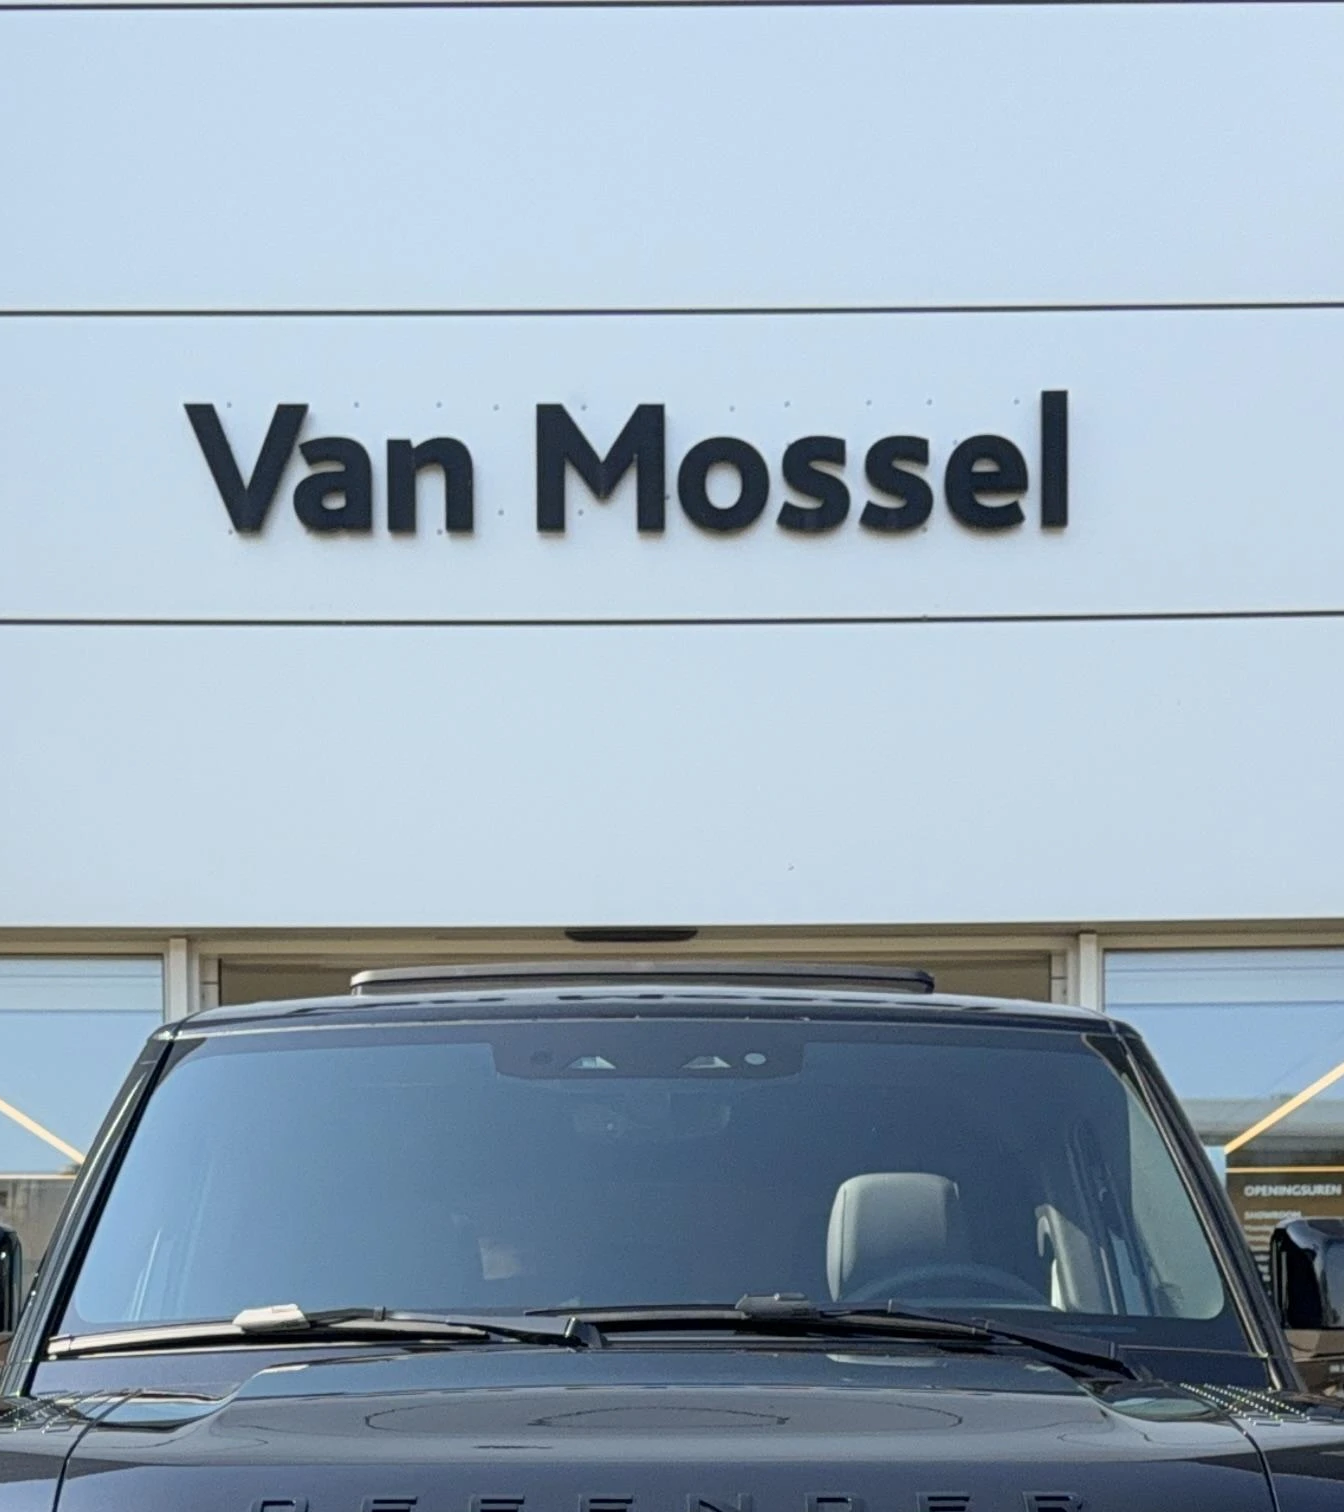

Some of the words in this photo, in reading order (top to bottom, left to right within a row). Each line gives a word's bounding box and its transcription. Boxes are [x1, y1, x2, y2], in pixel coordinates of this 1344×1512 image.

[184, 402, 474, 534] Van
[536, 389, 1068, 534] Mossel
[1243, 1183, 1343, 1197] OPENINGSUREN
